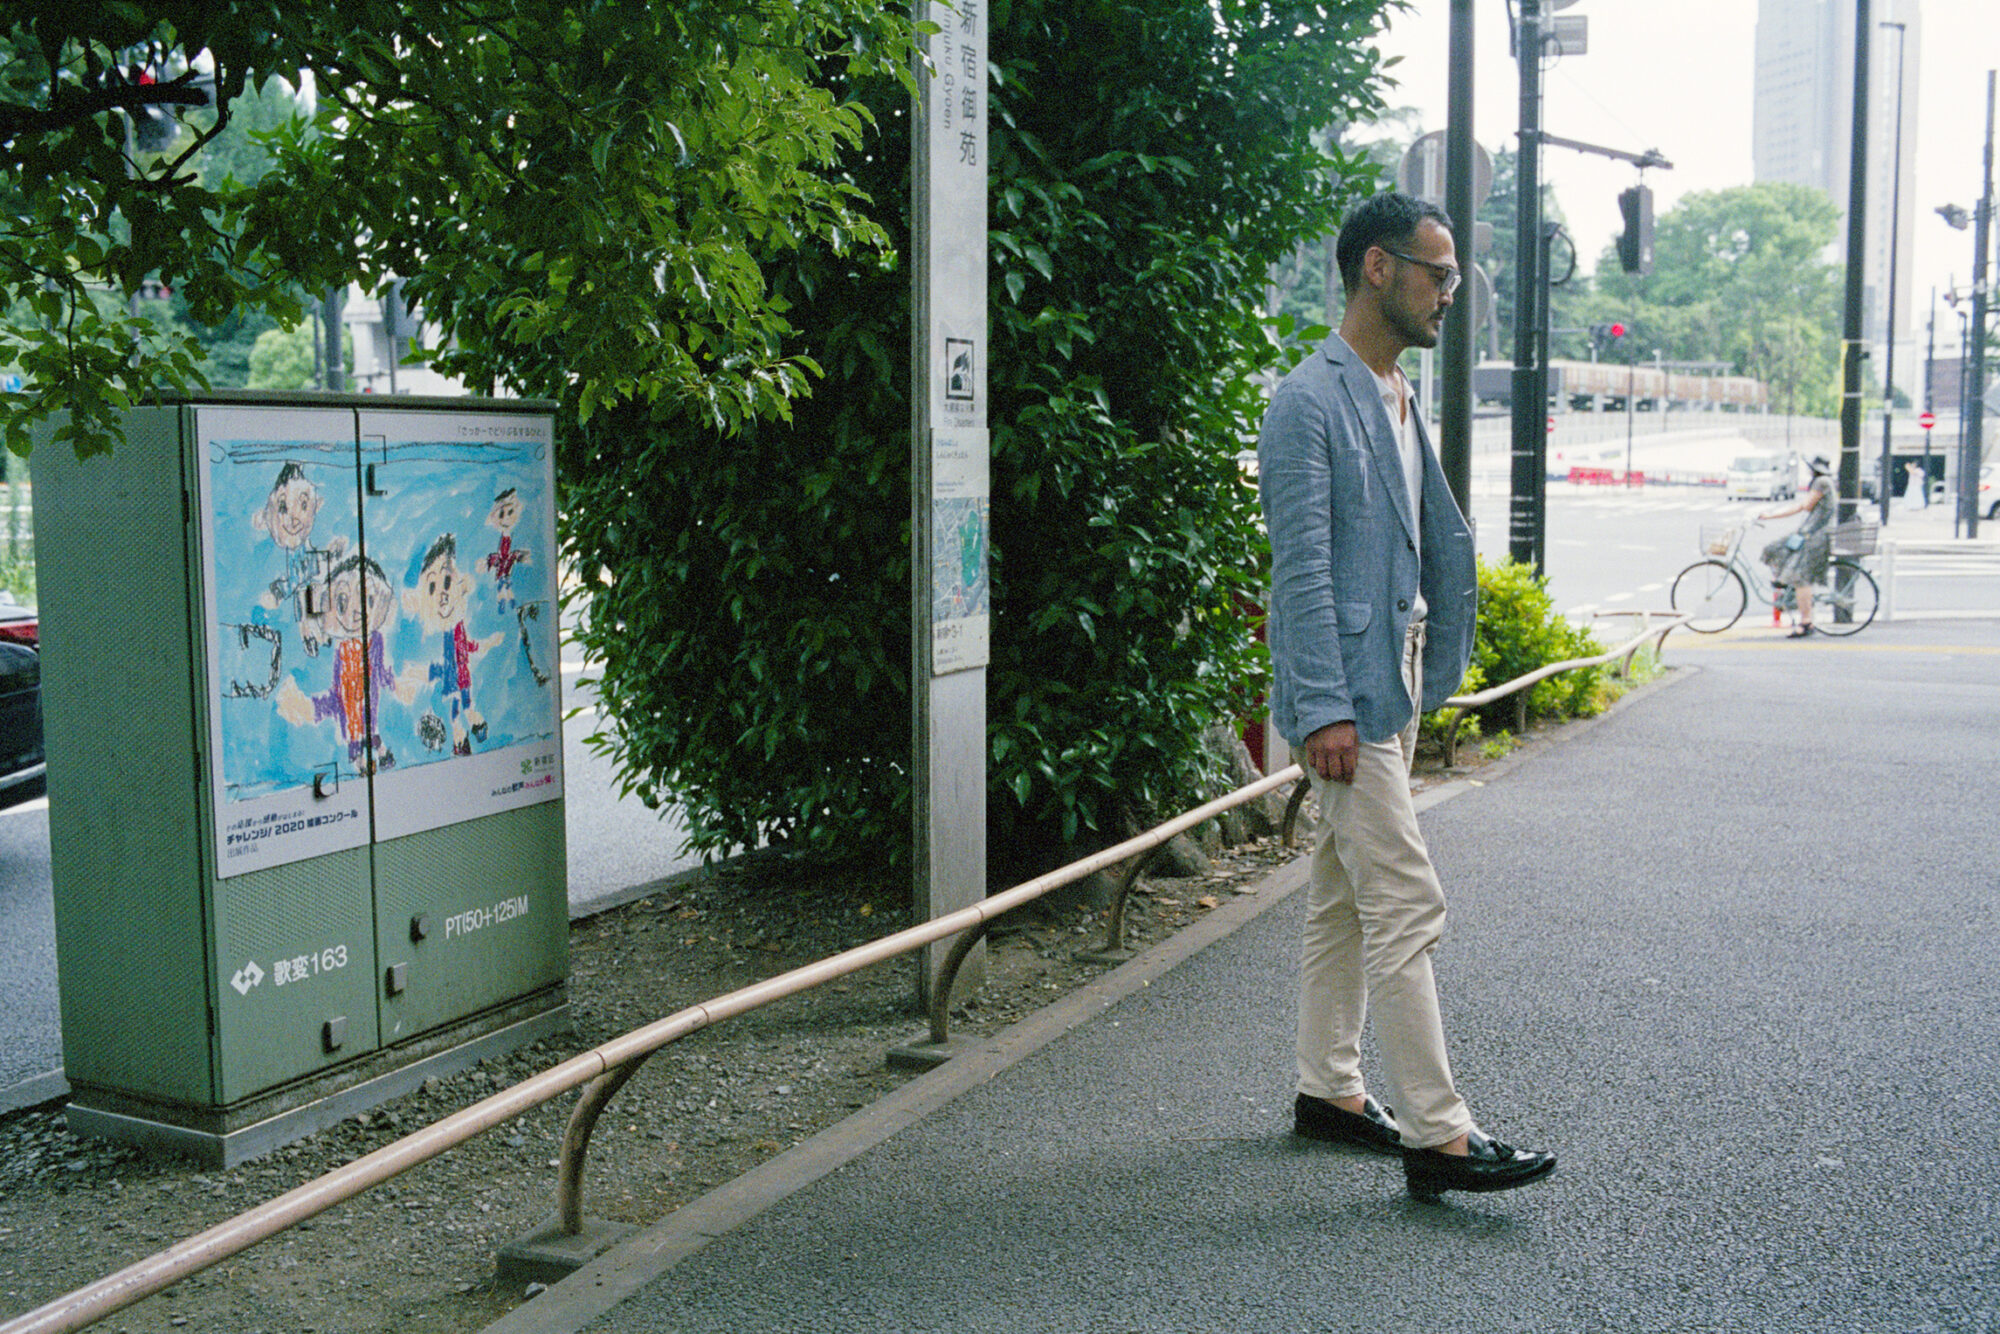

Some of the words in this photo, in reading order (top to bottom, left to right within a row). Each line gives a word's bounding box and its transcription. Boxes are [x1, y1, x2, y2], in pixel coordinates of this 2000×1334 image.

[943, 73, 954, 129] Gyoen
[445, 895, 529, 939] PT(50+125)M
[273, 944, 348, 986] 歌変163
